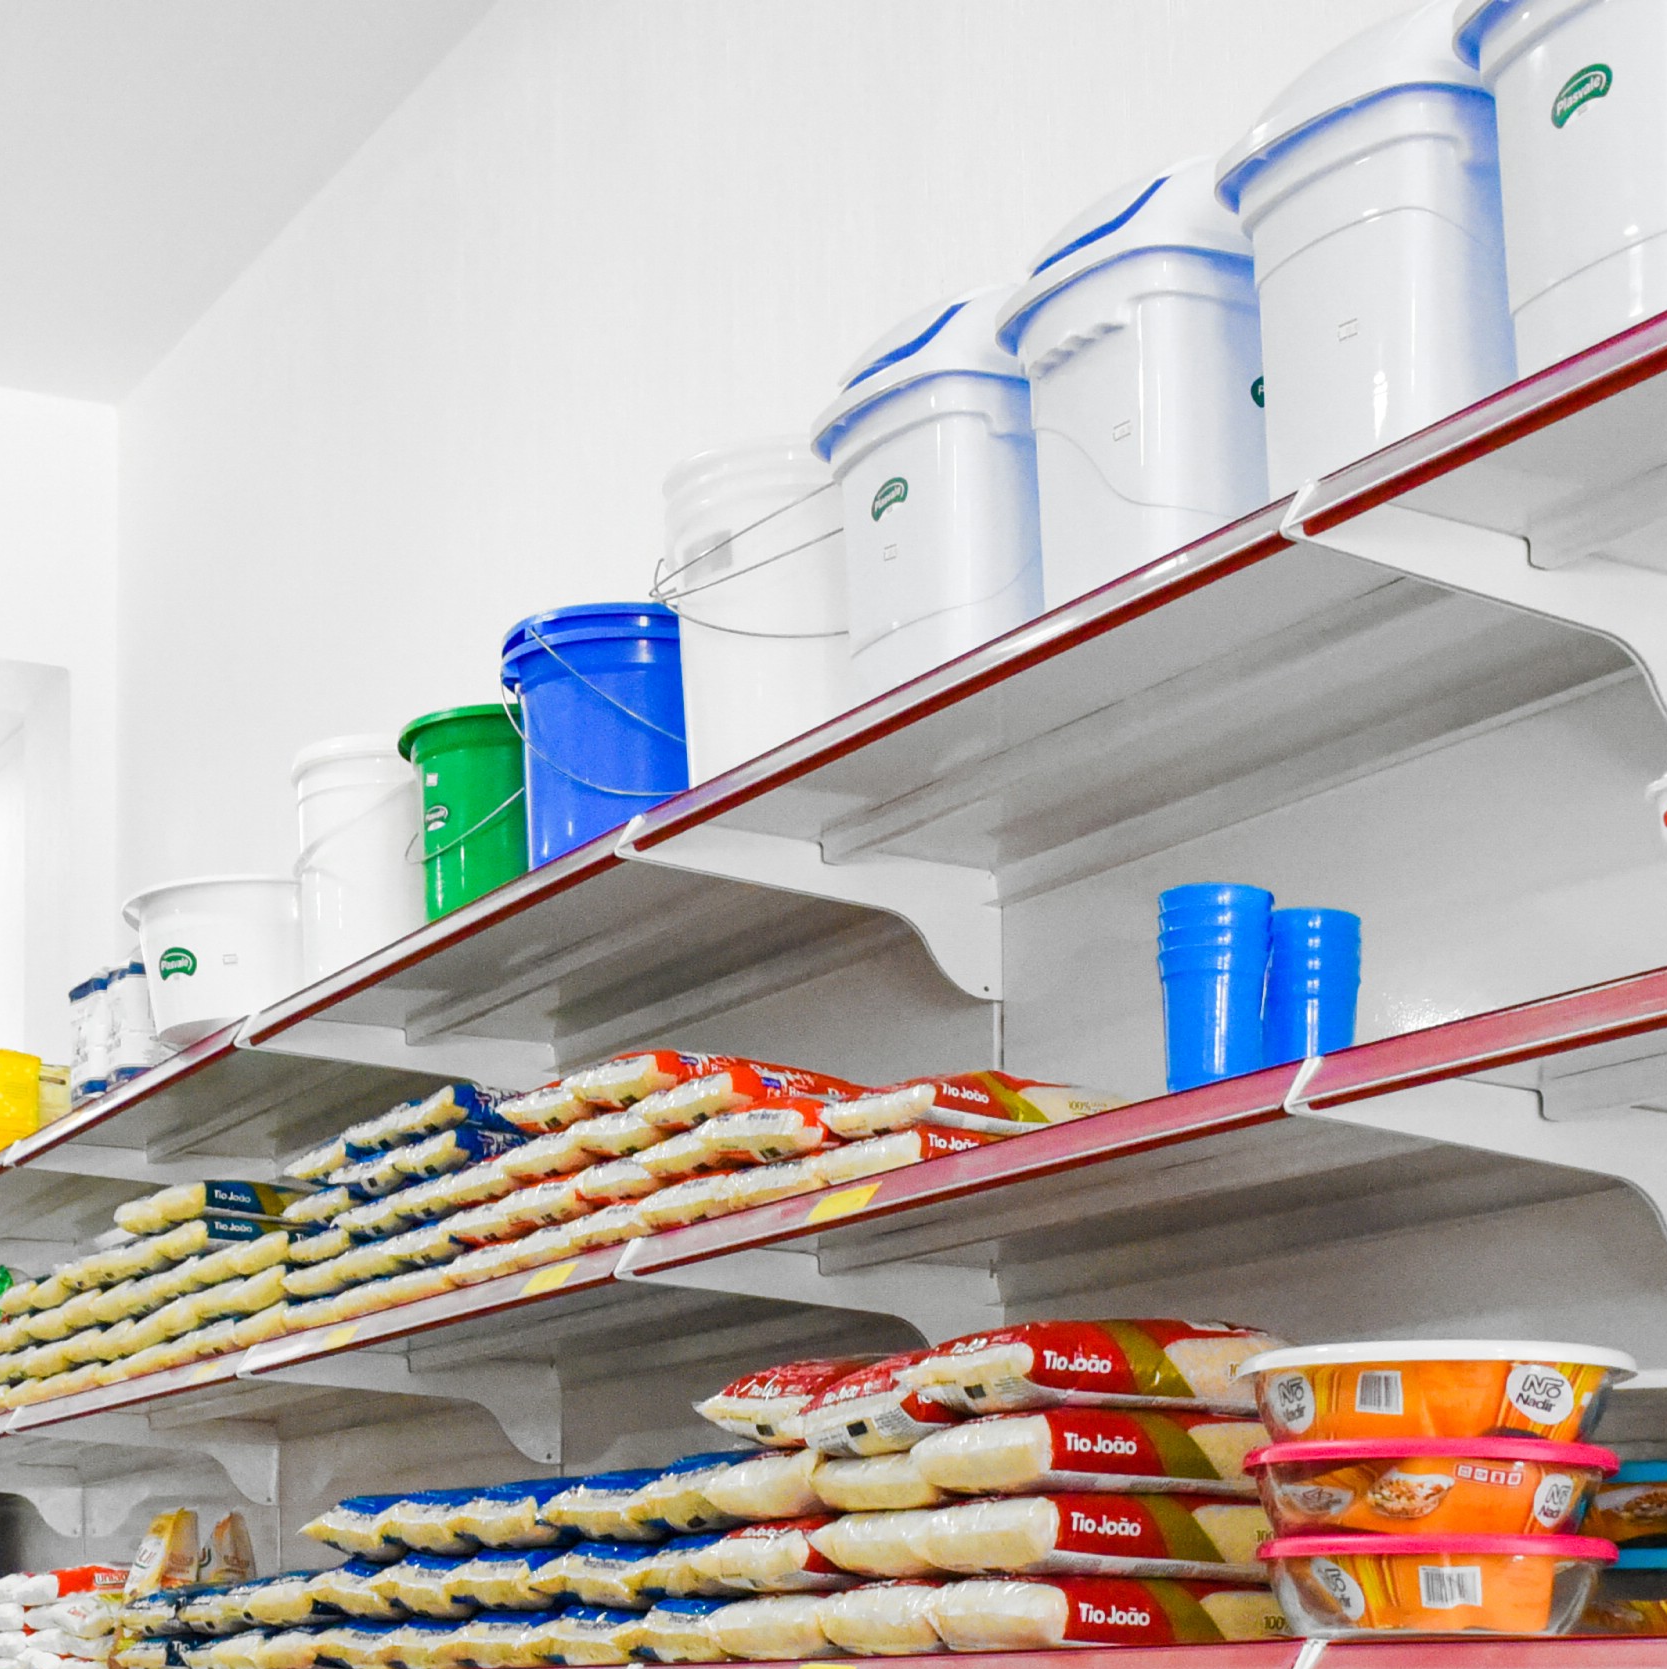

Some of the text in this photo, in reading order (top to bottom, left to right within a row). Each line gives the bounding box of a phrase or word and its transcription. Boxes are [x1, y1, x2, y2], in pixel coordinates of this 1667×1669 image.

[1556, 70, 1604, 119] Plasvale
[941, 1082, 959, 1097] Tio
[927, 1133, 946, 1149] Tio
[1043, 1350, 1112, 1374] Tio João
[1515, 1391, 1556, 1413] Nadir
[1064, 1432, 1137, 1455] Tio João
[1070, 1512, 1142, 1537] Tio João
[1078, 1602, 1151, 1627] Tio João
